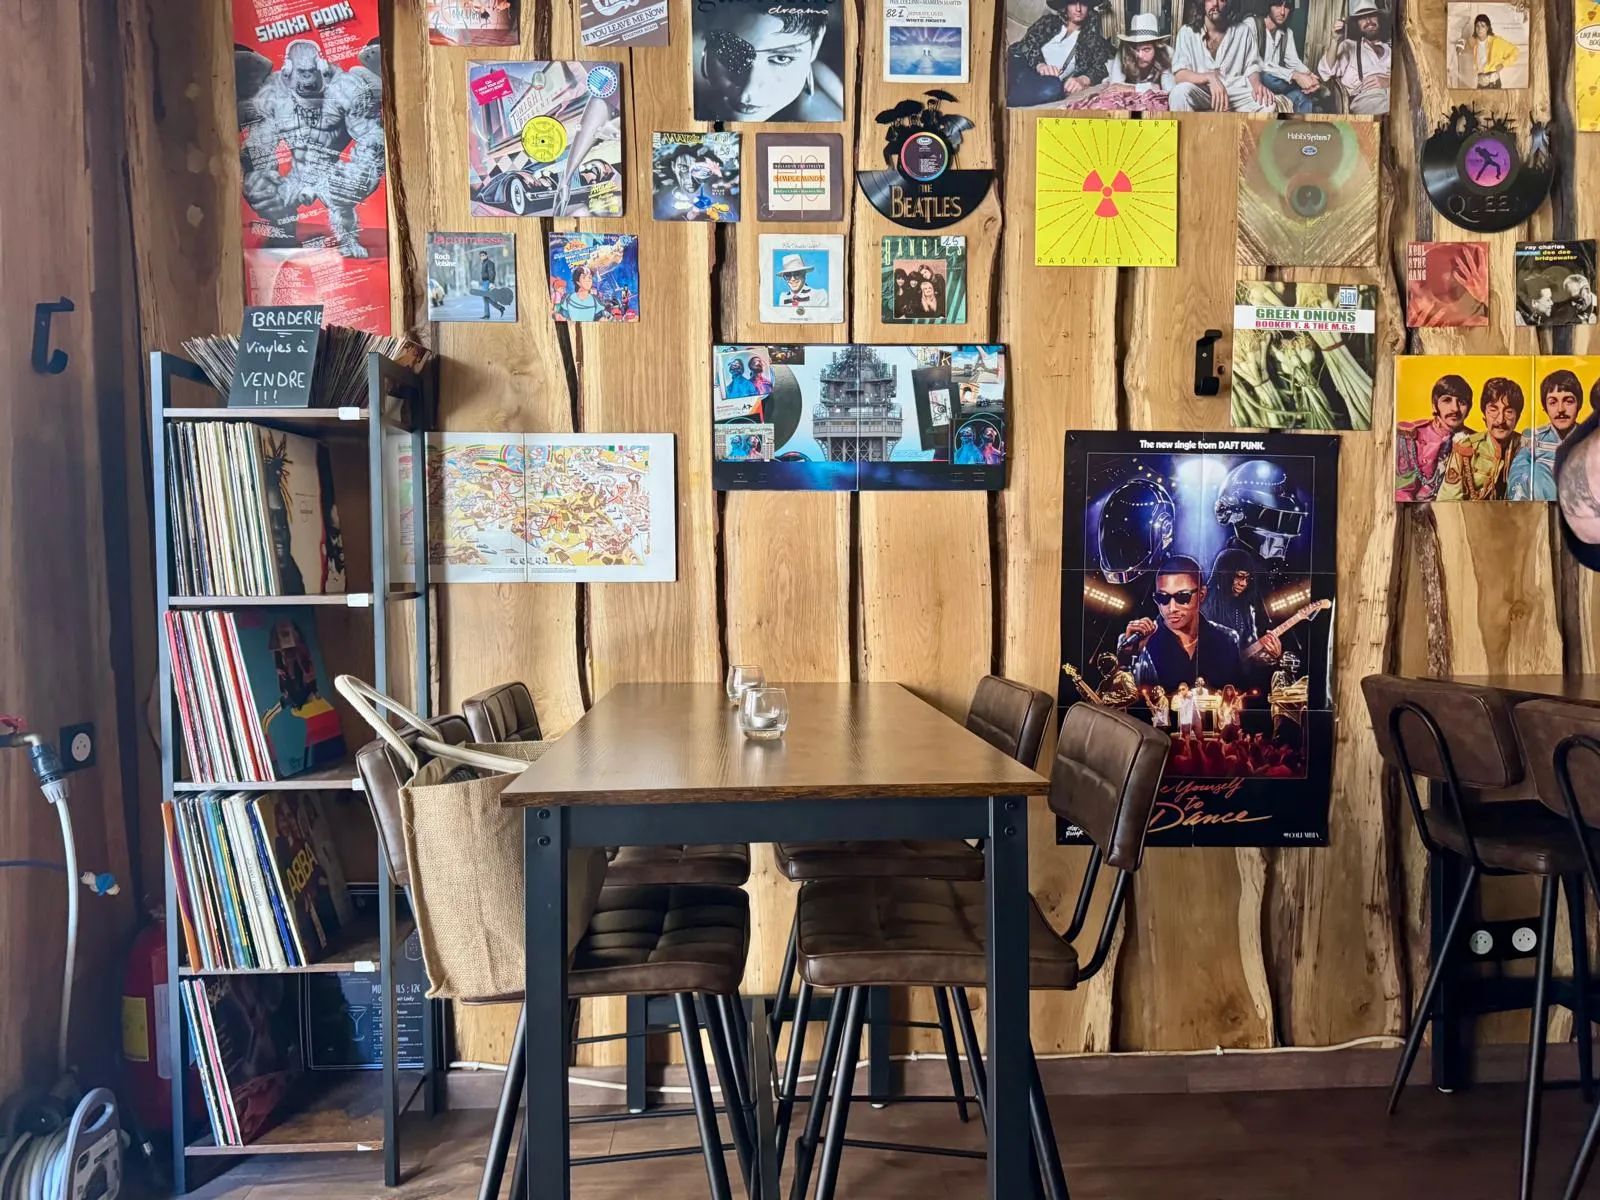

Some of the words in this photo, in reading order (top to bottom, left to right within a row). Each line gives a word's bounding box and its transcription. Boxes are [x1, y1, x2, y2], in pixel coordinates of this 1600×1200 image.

[768, 5, 829, 15] dreams
[255, 14, 310, 42] SHAKA
[311, 0, 354, 28] PONK
[583, 34, 591, 42] IF
[591, 28, 608, 39] YOU
[607, 19, 632, 35] LEAVE
[632, 13, 646, 25] ME
[645, 6, 665, 20] NOW
[1039, 119, 1176, 128] KRAFTWERK
[920, 183, 933, 193] THE
[890, 185, 962, 223] BEATLES
[1037, 257, 1176, 265] RADIOACTIVITY
[251, 310, 322, 327] BRADERIE
[1256, 308, 1300, 320] GREEN
[1303, 309, 1356, 322] ONIONS
[1256, 320, 1292, 329] BOOKER
[1294, 321, 1301, 329] T.
[1313, 322, 1329, 330] THE
[246, 340, 291, 362] Vinyles
[297, 340, 308, 353] à
[241, 370, 305, 388] VENDRE
[1140, 440, 1154, 449] The
[1156, 441, 1173, 449] new
[1174, 440, 1196, 450] single
[1198, 440, 1217, 449] from
[1218, 441, 1240, 449] DAFT
[1241, 441, 1265, 450] PUNK.
[1174, 776, 1245, 803] Yourself
[1184, 795, 1204, 811] to
[1147, 802, 1272, 833] Dance
[287, 841, 318, 901] ABBA
